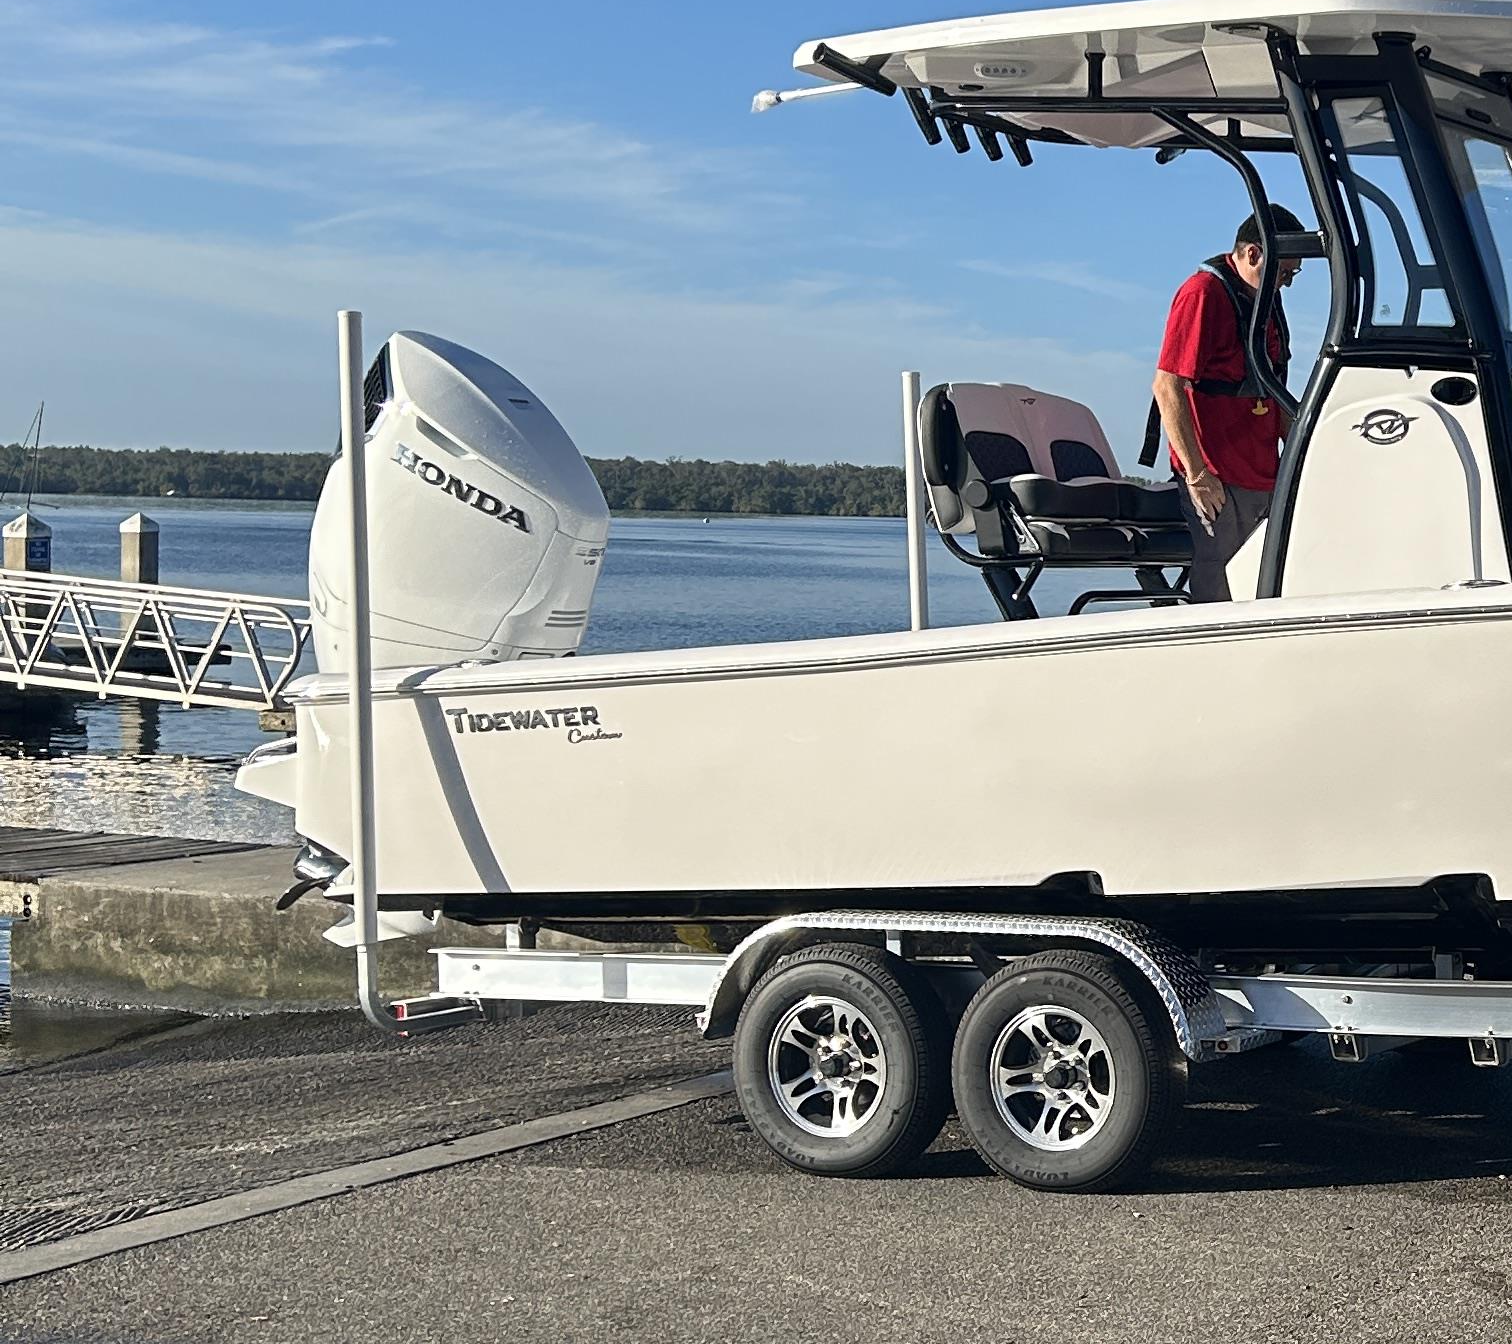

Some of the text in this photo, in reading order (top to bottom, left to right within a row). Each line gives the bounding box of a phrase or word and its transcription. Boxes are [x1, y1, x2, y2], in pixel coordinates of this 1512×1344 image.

[390, 440, 532, 535] HONDA
[445, 706, 600, 734] TIDEWATER
[567, 728, 623, 744] Custom
